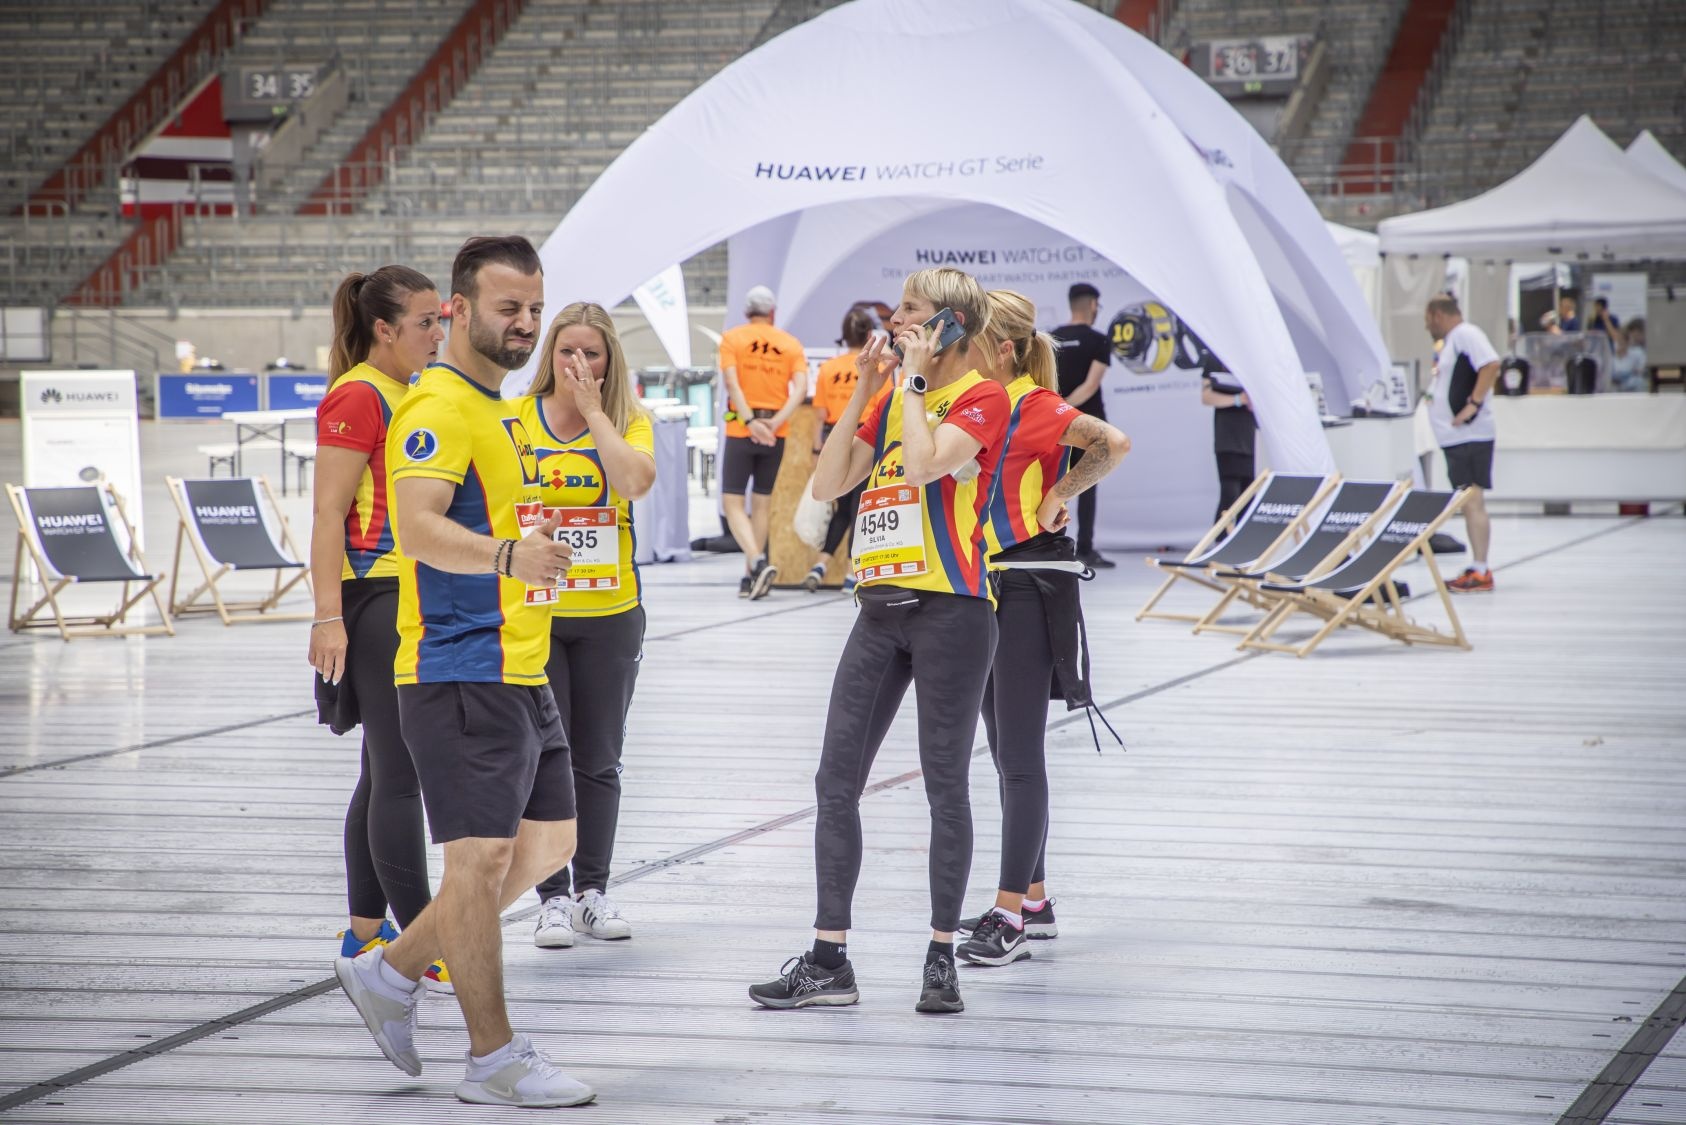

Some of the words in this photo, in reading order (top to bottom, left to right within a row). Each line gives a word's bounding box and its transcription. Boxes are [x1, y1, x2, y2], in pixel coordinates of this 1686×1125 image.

[1223, 47, 1251, 75] 36
[1264, 49, 1292, 73] 37
[251, 73, 276, 97] 34
[290, 73, 314, 97] 35
[756, 162, 866, 181] HUAWEI
[876, 161, 954, 180] WATCH
[959, 158, 990, 177] GT
[994, 152, 1045, 174] Serie
[916, 249, 996, 264] HUAWEI
[1002, 248, 1060, 264] WATCH
[1063, 246, 1085, 262] GT
[1112, 323, 1134, 343] 10
[66, 392, 119, 402] HUAWEI
[38, 514, 103, 528] HUAWEI
[196, 505, 256, 517] HUAWEI
[861, 509, 899, 536] 4549
[551, 530, 598, 549] 535
[869, 535, 886, 544] SILVIA
